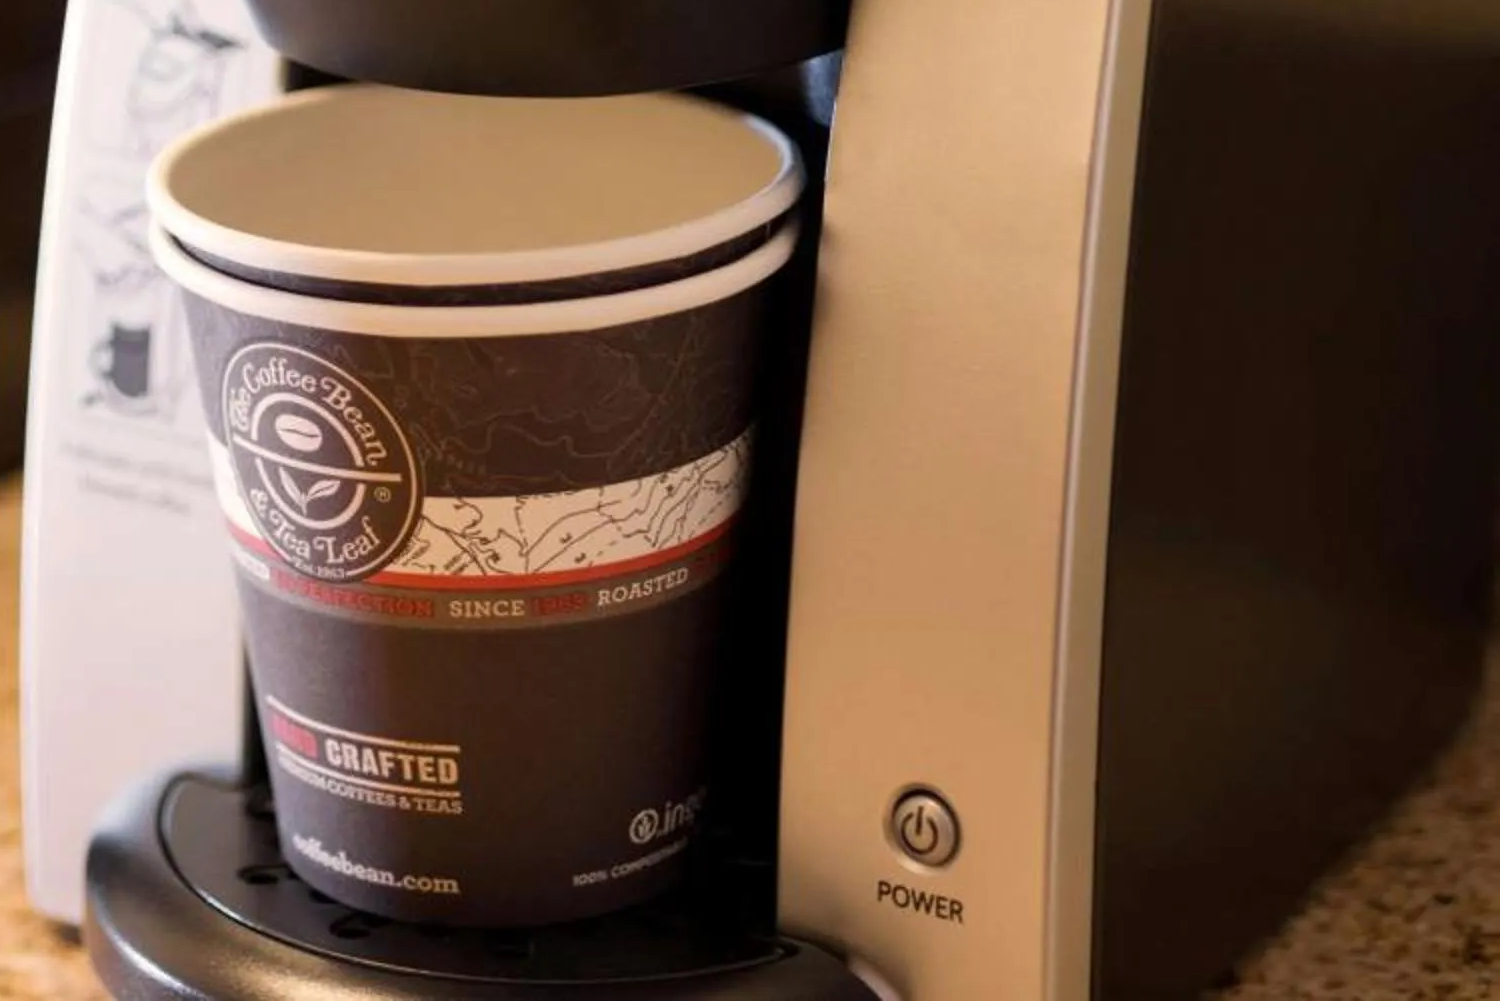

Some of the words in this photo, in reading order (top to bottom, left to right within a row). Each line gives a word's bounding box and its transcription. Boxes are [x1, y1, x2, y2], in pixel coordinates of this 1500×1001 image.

[241, 356, 318, 394] Coffee
[319, 374, 389, 466] Bean
[270, 512, 311, 559] Tea
[313, 514, 381, 565] Leaf
[450, 599, 527, 619] SINCE
[596, 566, 690, 606] ROASTED
[324, 737, 460, 784] CRAFTED
[414, 799, 463, 815] TEAS
[877, 880, 964, 924] POWER
